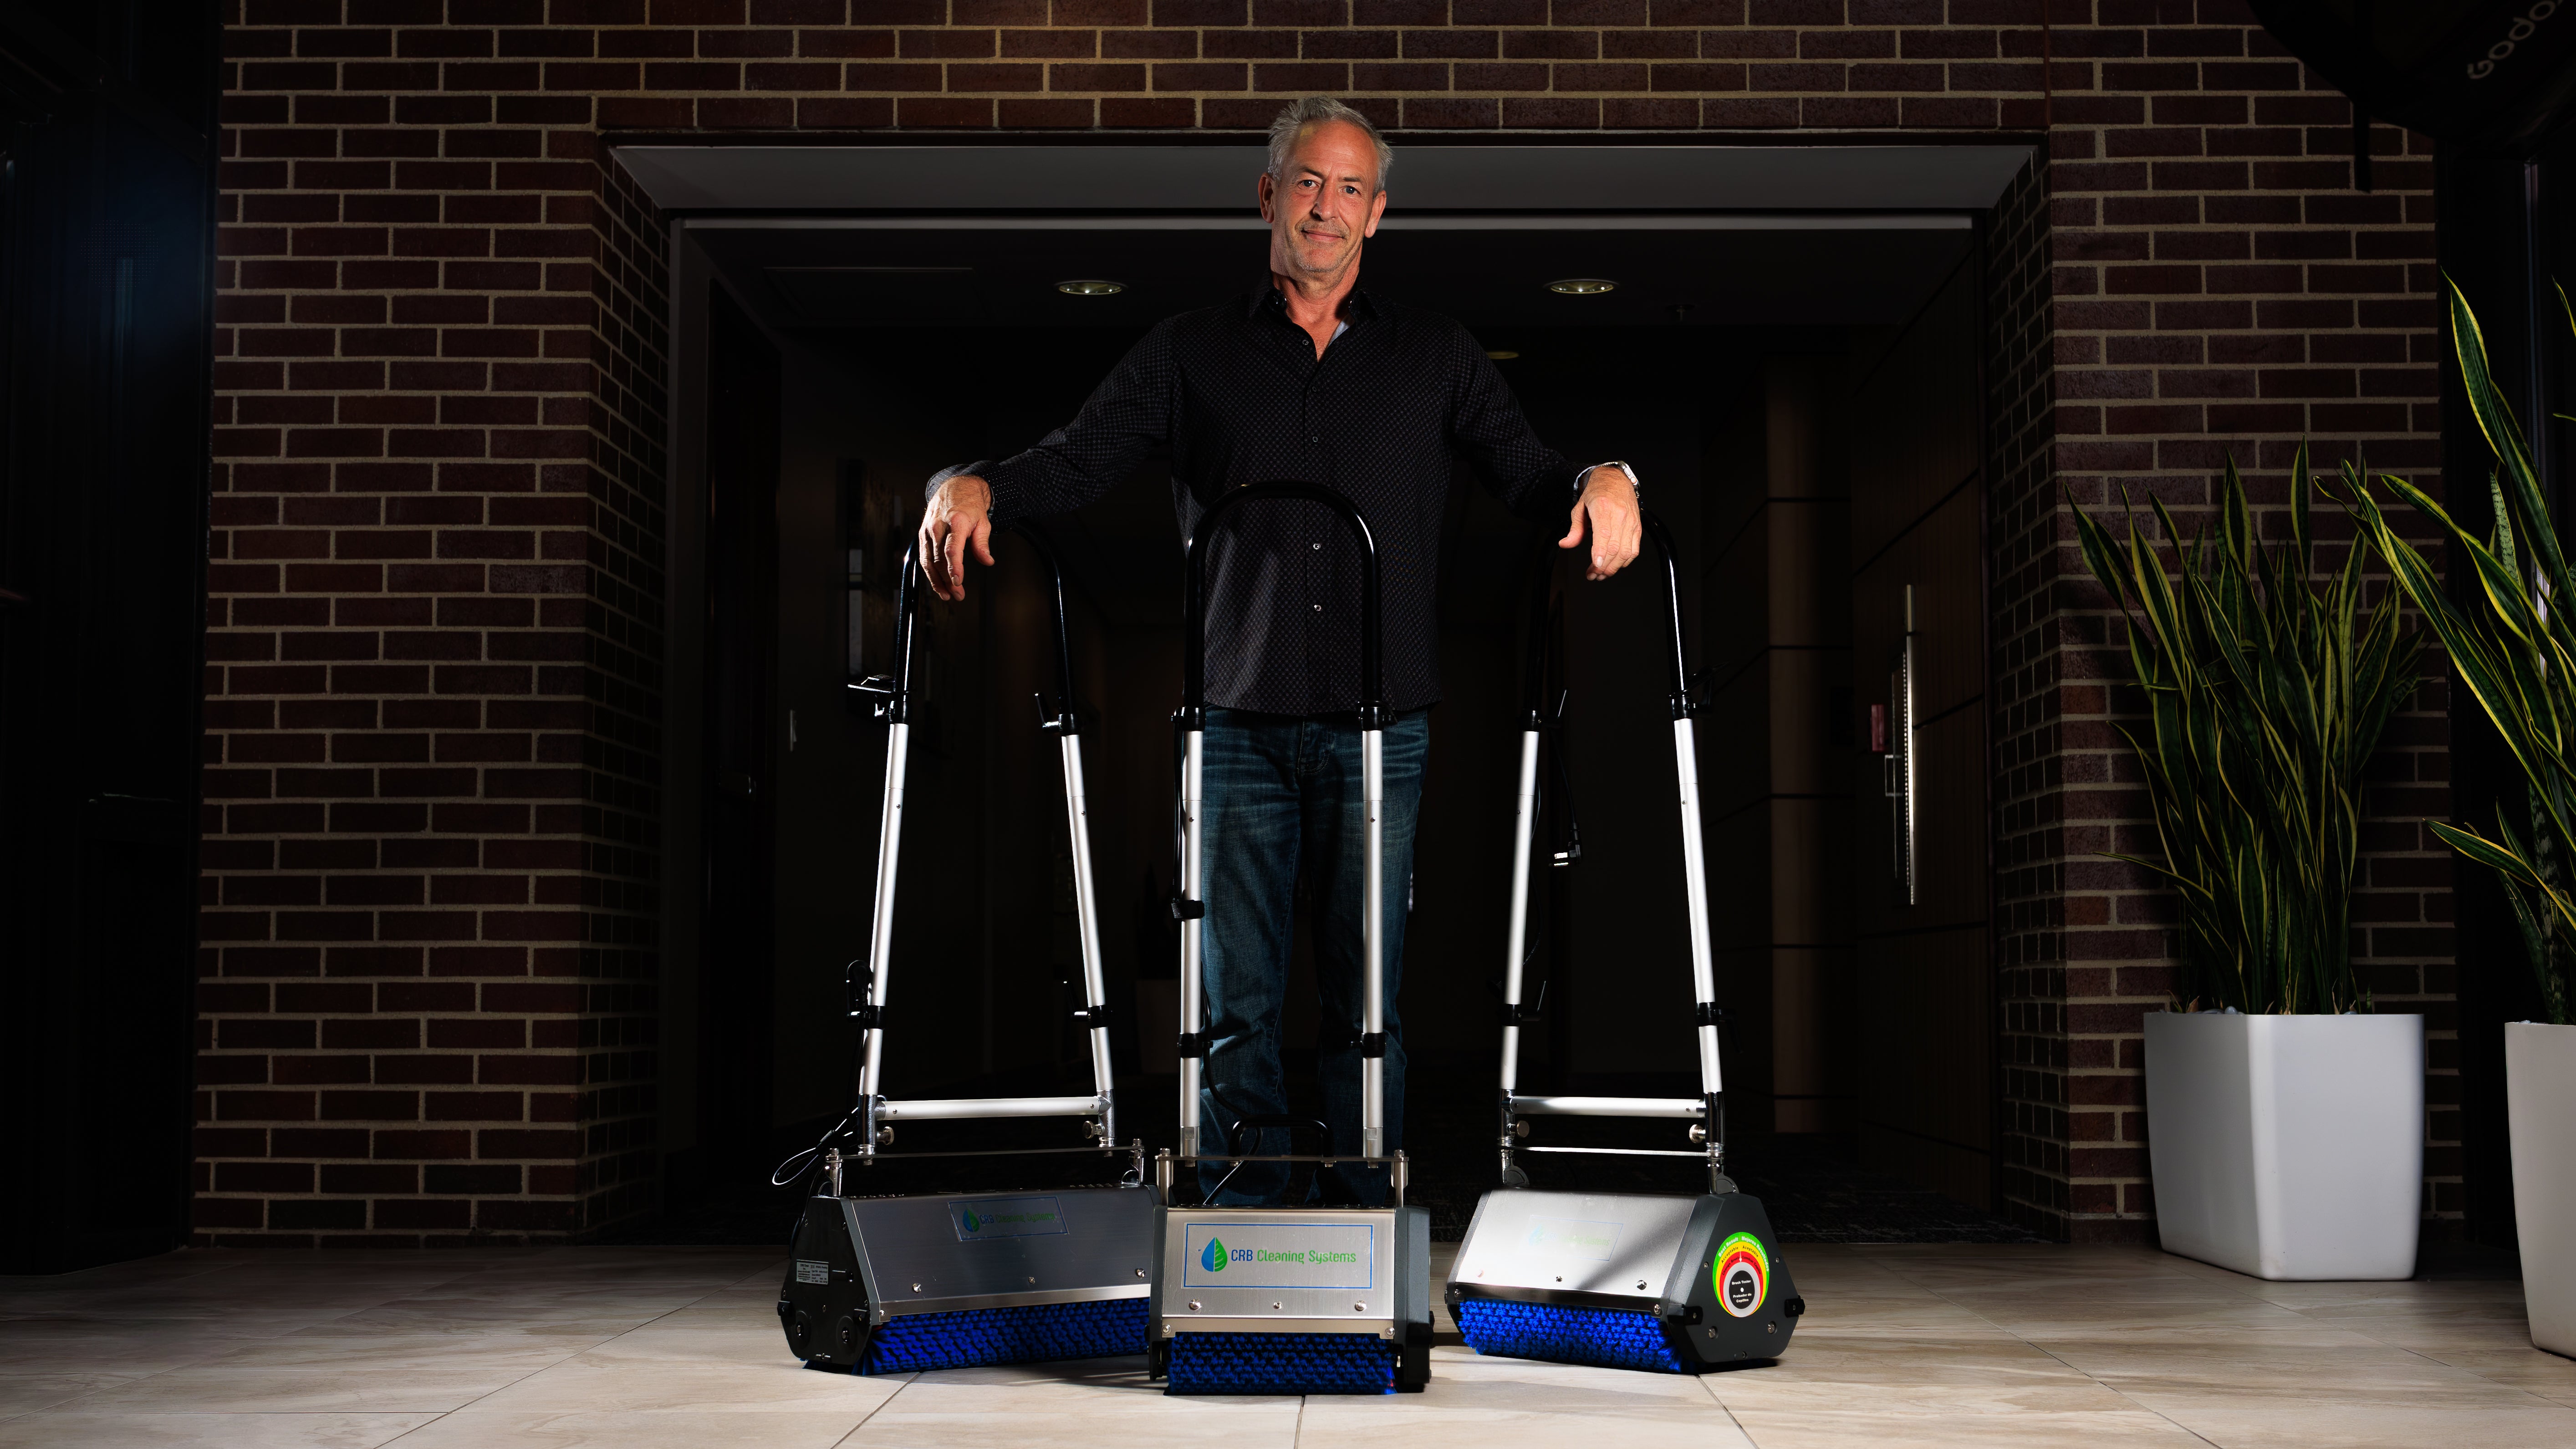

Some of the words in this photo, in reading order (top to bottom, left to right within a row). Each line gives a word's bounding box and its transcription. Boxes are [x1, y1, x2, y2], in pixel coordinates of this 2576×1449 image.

[2467, 0, 2564, 80] Godo
[979, 1214, 994, 1224] CRB
[996, 1214, 1025, 1223] Cleaning
[1027, 1213, 1055, 1222] Systems
[1726, 1237, 1739, 1247] Result
[1231, 1250, 1253, 1261] CRB
[1257, 1250, 1304, 1264] Cleaning
[1309, 1250, 1356, 1264] Systems
[1721, 1247, 1739, 1264] Acceptable
[1741, 1236, 1756, 1246] Mejores
[1756, 1245, 1769, 1271] Resultados
[1742, 1245, 1759, 1257] Aceptable
